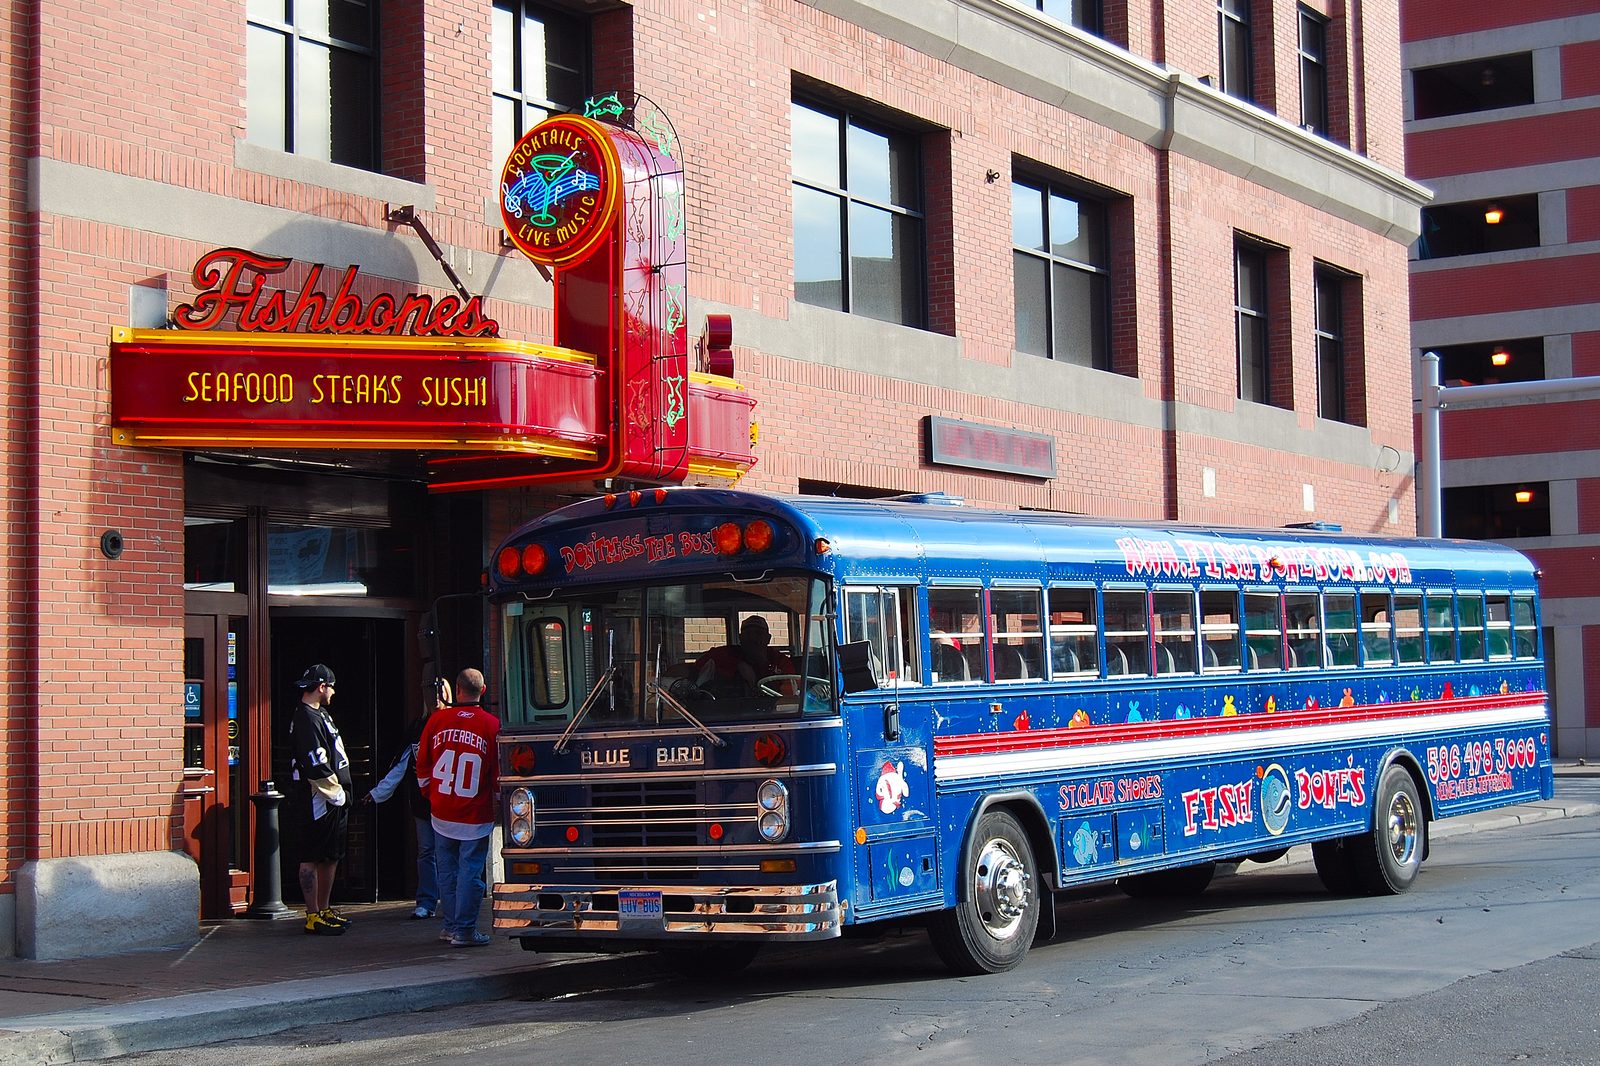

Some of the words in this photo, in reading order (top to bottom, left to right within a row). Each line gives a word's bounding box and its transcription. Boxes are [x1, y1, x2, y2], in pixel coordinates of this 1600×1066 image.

[508, 129, 582, 175] COCKTAILS
[519, 223, 551, 247] LIVE
[556, 195, 595, 244] MUSIC
[172, 247, 500, 337] Fishbones
[184, 372, 294, 404] SEAFOOD
[311, 374, 403, 405] STEAKS
[420, 375, 488, 407] SUSHI
[560, 532, 605, 574] DON'T
[644, 533, 677, 564] THE
[308, 747, 328, 766] 12
[432, 728, 488, 755] ZETTERBERG
[581, 748, 631, 766] BLUE
[656, 746, 704, 764] BIRD
[1426, 743, 1461, 785] 586
[1464, 740, 1493, 777] 498
[1495, 737, 1536, 774] 3000
[432, 749, 483, 799] 40
[1117, 775, 1163, 803] SHORES
[1181, 778, 1254, 837] FISH
[1295, 753, 1365, 809] BONE'S
[620, 899, 638, 913] LUV
[643, 899, 661, 913] BUS
